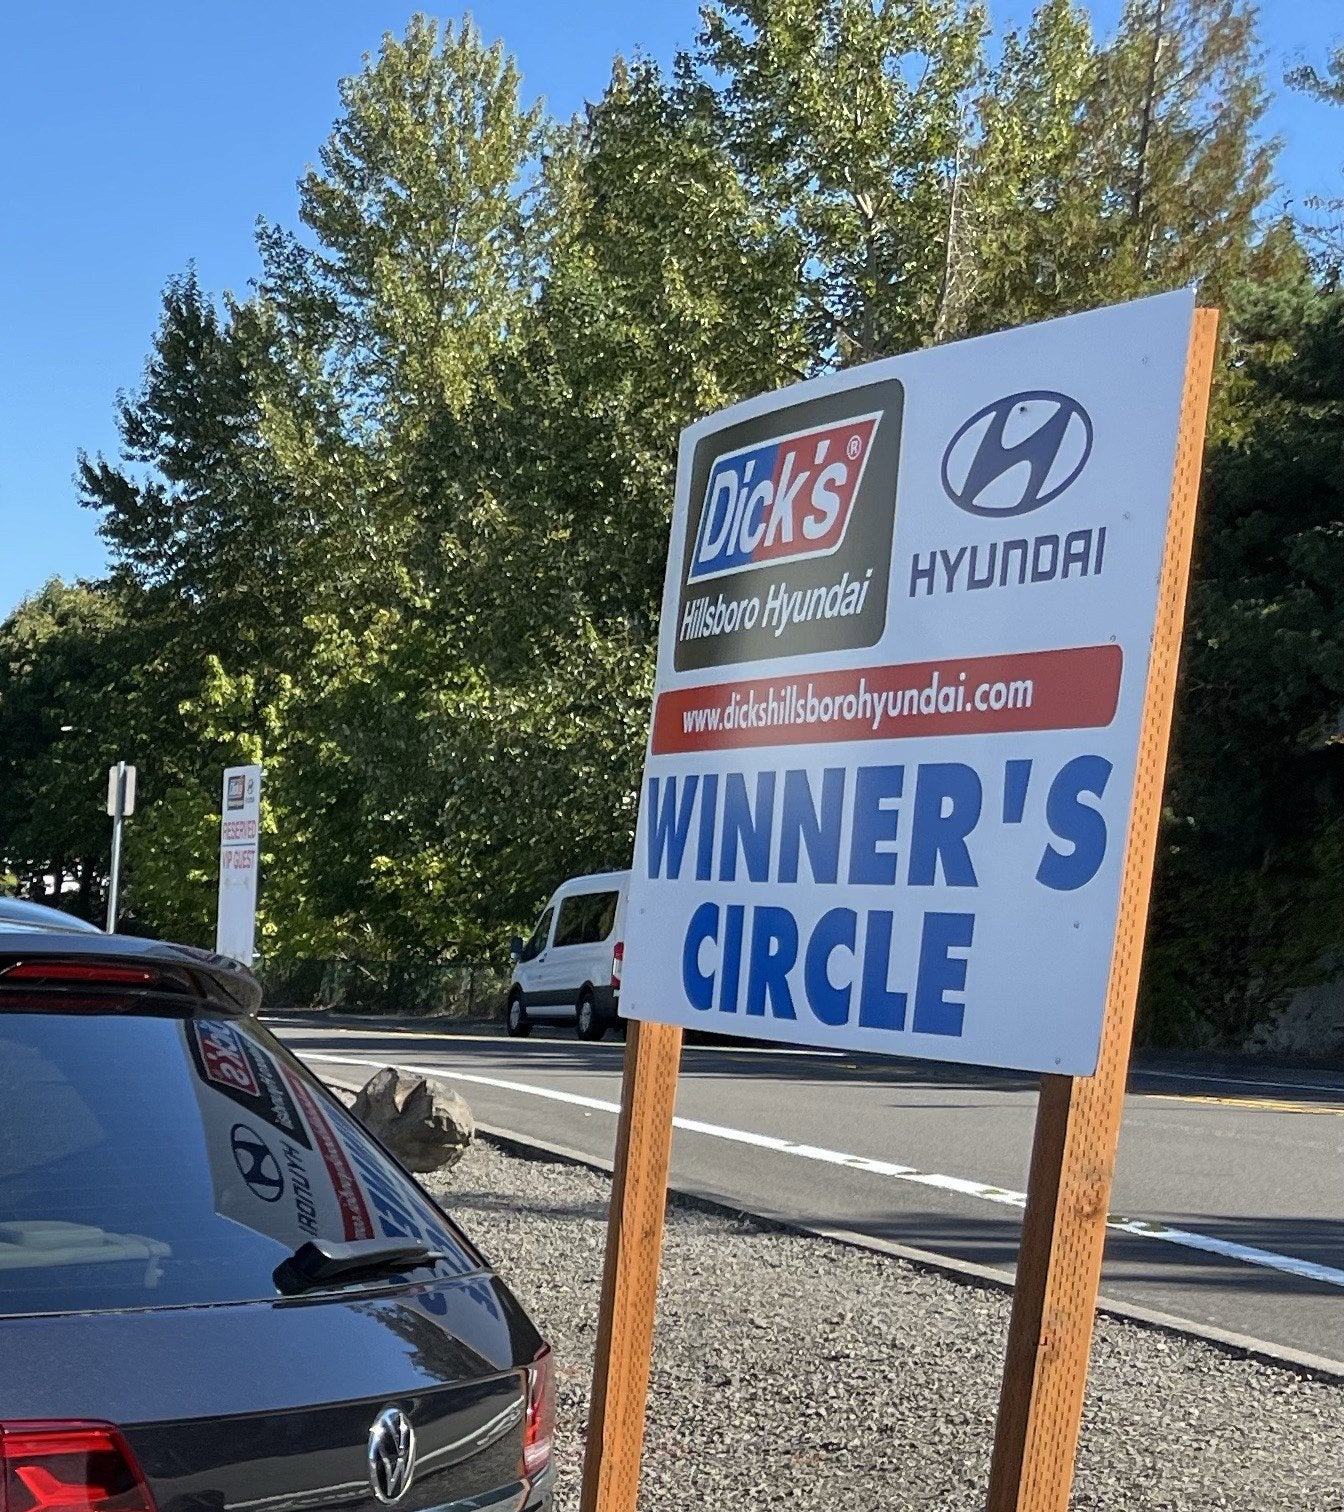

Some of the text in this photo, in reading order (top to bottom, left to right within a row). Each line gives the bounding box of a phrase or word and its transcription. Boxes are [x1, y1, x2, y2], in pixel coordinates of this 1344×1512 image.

[909, 526, 1107, 598] HYUNDAI
[679, 568, 874, 642] Hillsboro Hyundai
[682, 671, 1034, 733] www.dickshillsborohyundai.com
[648, 754, 1113, 891] WINNER'S
[682, 901, 976, 1038] CIRCLE
